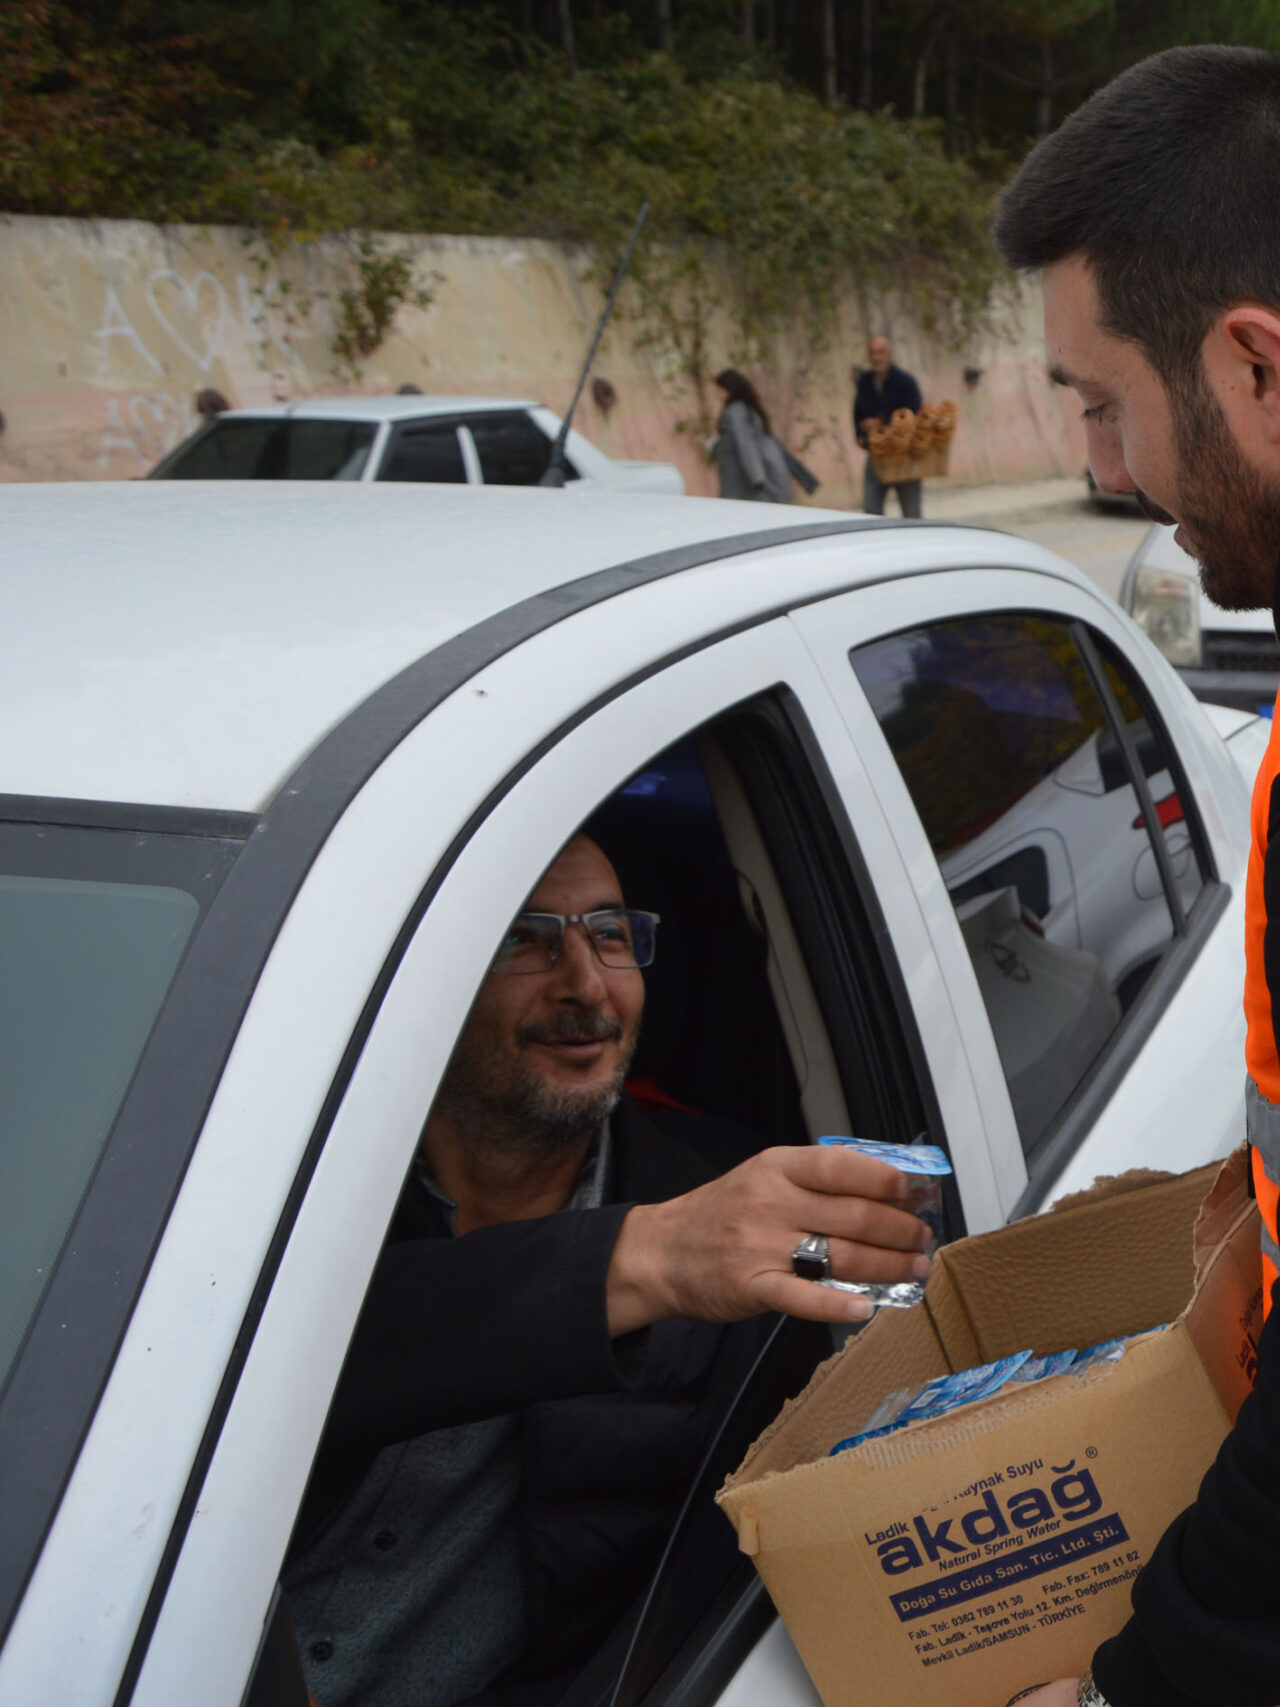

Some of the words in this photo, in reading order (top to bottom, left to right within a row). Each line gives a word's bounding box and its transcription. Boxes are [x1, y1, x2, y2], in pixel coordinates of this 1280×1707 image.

[864, 1522, 910, 1546] Ladik
[953, 1471, 1005, 1500] aynak
[1006, 1458, 1044, 1479] Suyu
[877, 1459, 1102, 1575] akdağ
[938, 1548, 981, 1571] Natural
[984, 1535, 1024, 1556] Spring
[1027, 1520, 1062, 1539] Water
[938, 1587, 958, 1599] Su
[960, 1574, 993, 1592] Gıda
[995, 1561, 1029, 1579] San.
[1030, 1551, 1059, 1566] Tic.
[1061, 1537, 1090, 1555] Ltd.
[1093, 1525, 1119, 1544] Şti.
[1042, 1581, 1066, 1595] Fab.
[1066, 1571, 1090, 1585] Fax:
[1090, 1562, 1111, 1576] 789
[1113, 1556, 1125, 1568] 11
[1126, 1550, 1140, 1562] 82
[908, 1625, 932, 1641] Fab.
[976, 1605, 996, 1618] 789
[997, 1599, 1009, 1610] 11
[1010, 1594, 1024, 1606] 30
[915, 1641, 938, 1654] Fab.
[938, 1631, 967, 1647] Ladik
[1010, 1607, 1034, 1622] Yolu
[1036, 1601, 1052, 1613] 12.
[1052, 1593, 1074, 1607] Km.
[1037, 1603, 1086, 1627] TÜRKİYE
